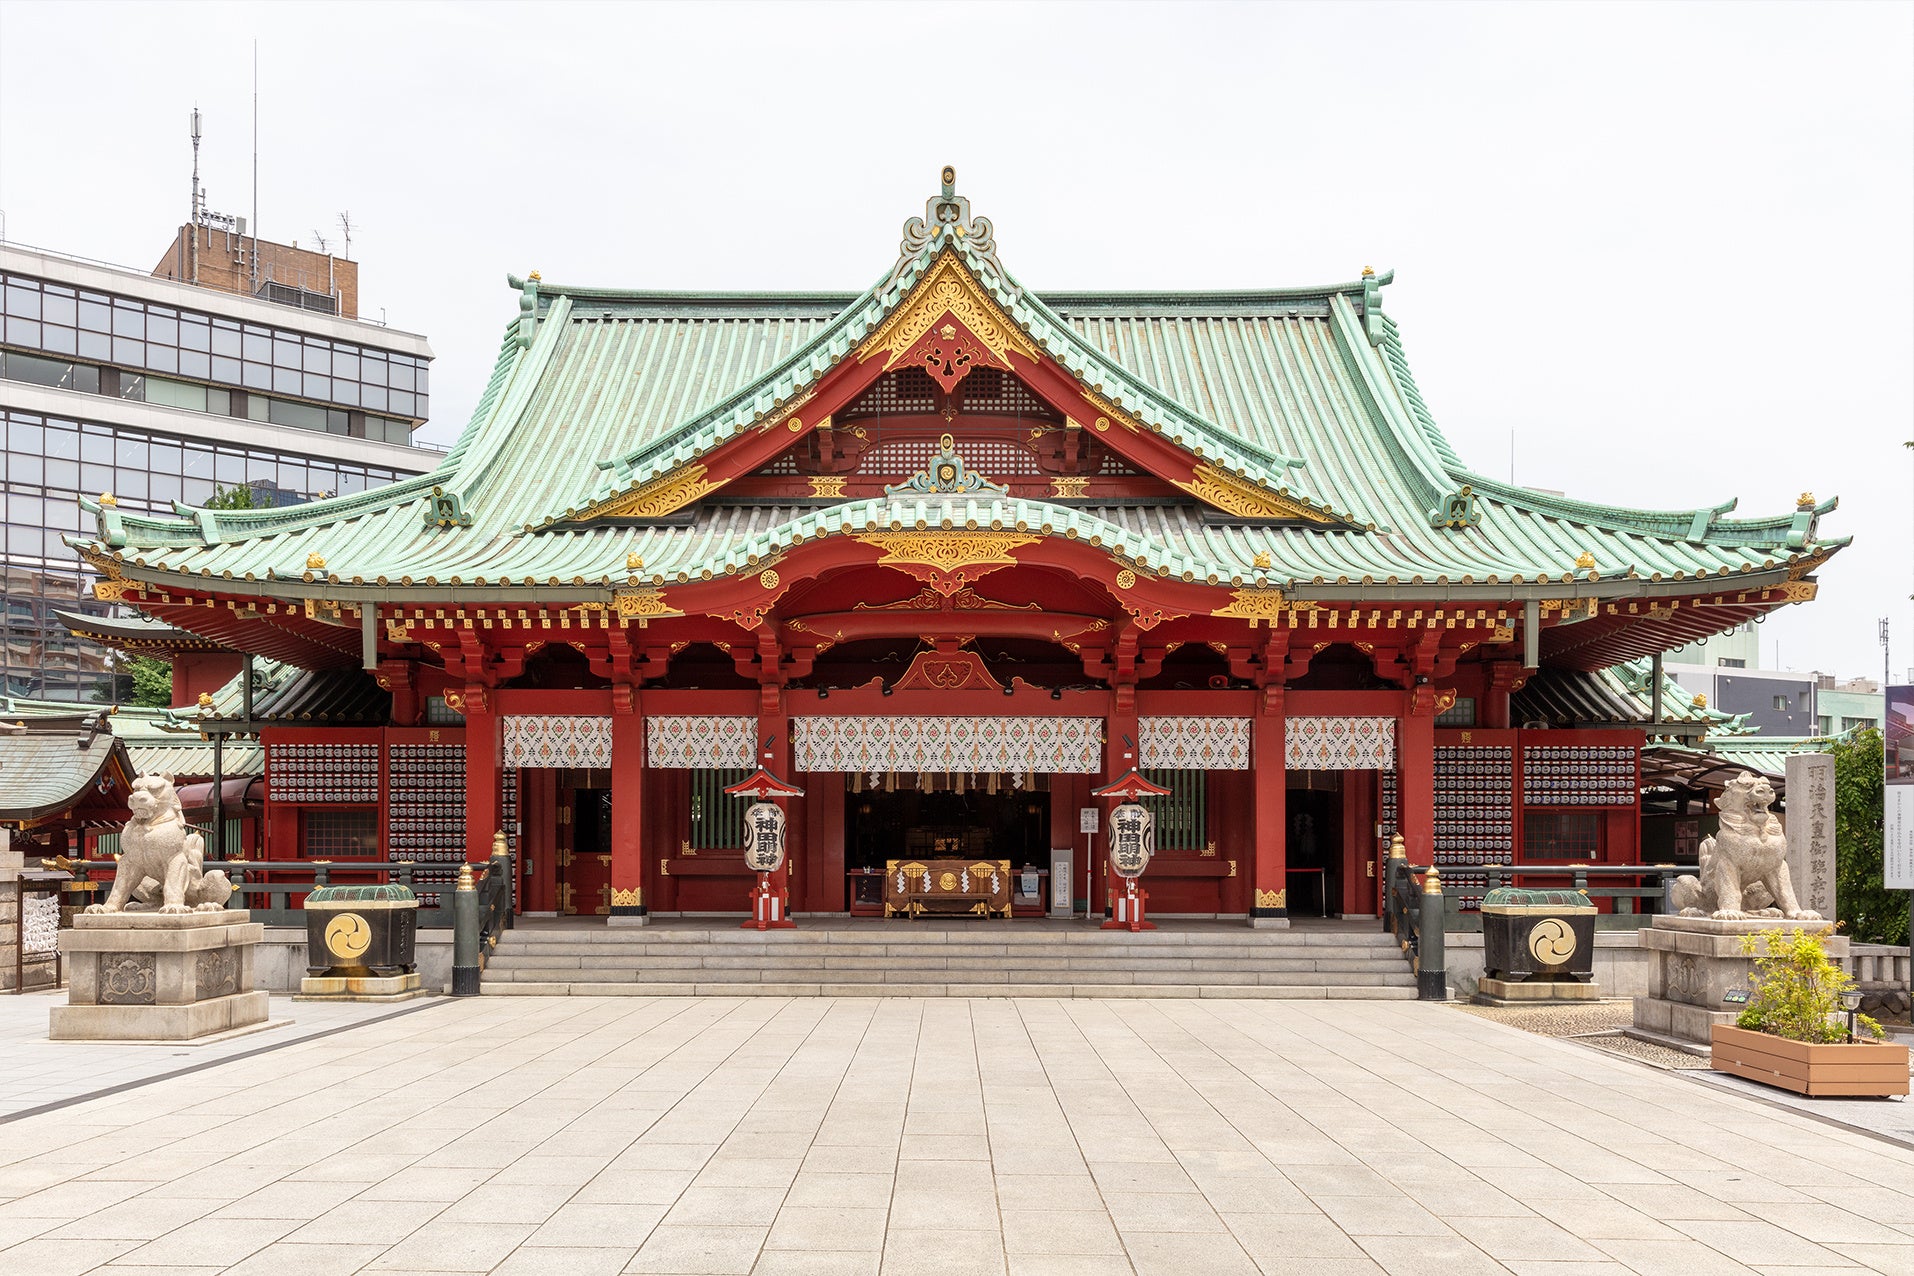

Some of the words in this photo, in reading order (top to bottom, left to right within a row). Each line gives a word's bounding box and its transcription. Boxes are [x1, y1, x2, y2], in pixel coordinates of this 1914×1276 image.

[755, 817, 778, 866] 神田明神
[1117, 819, 1142, 867] 神田明神
